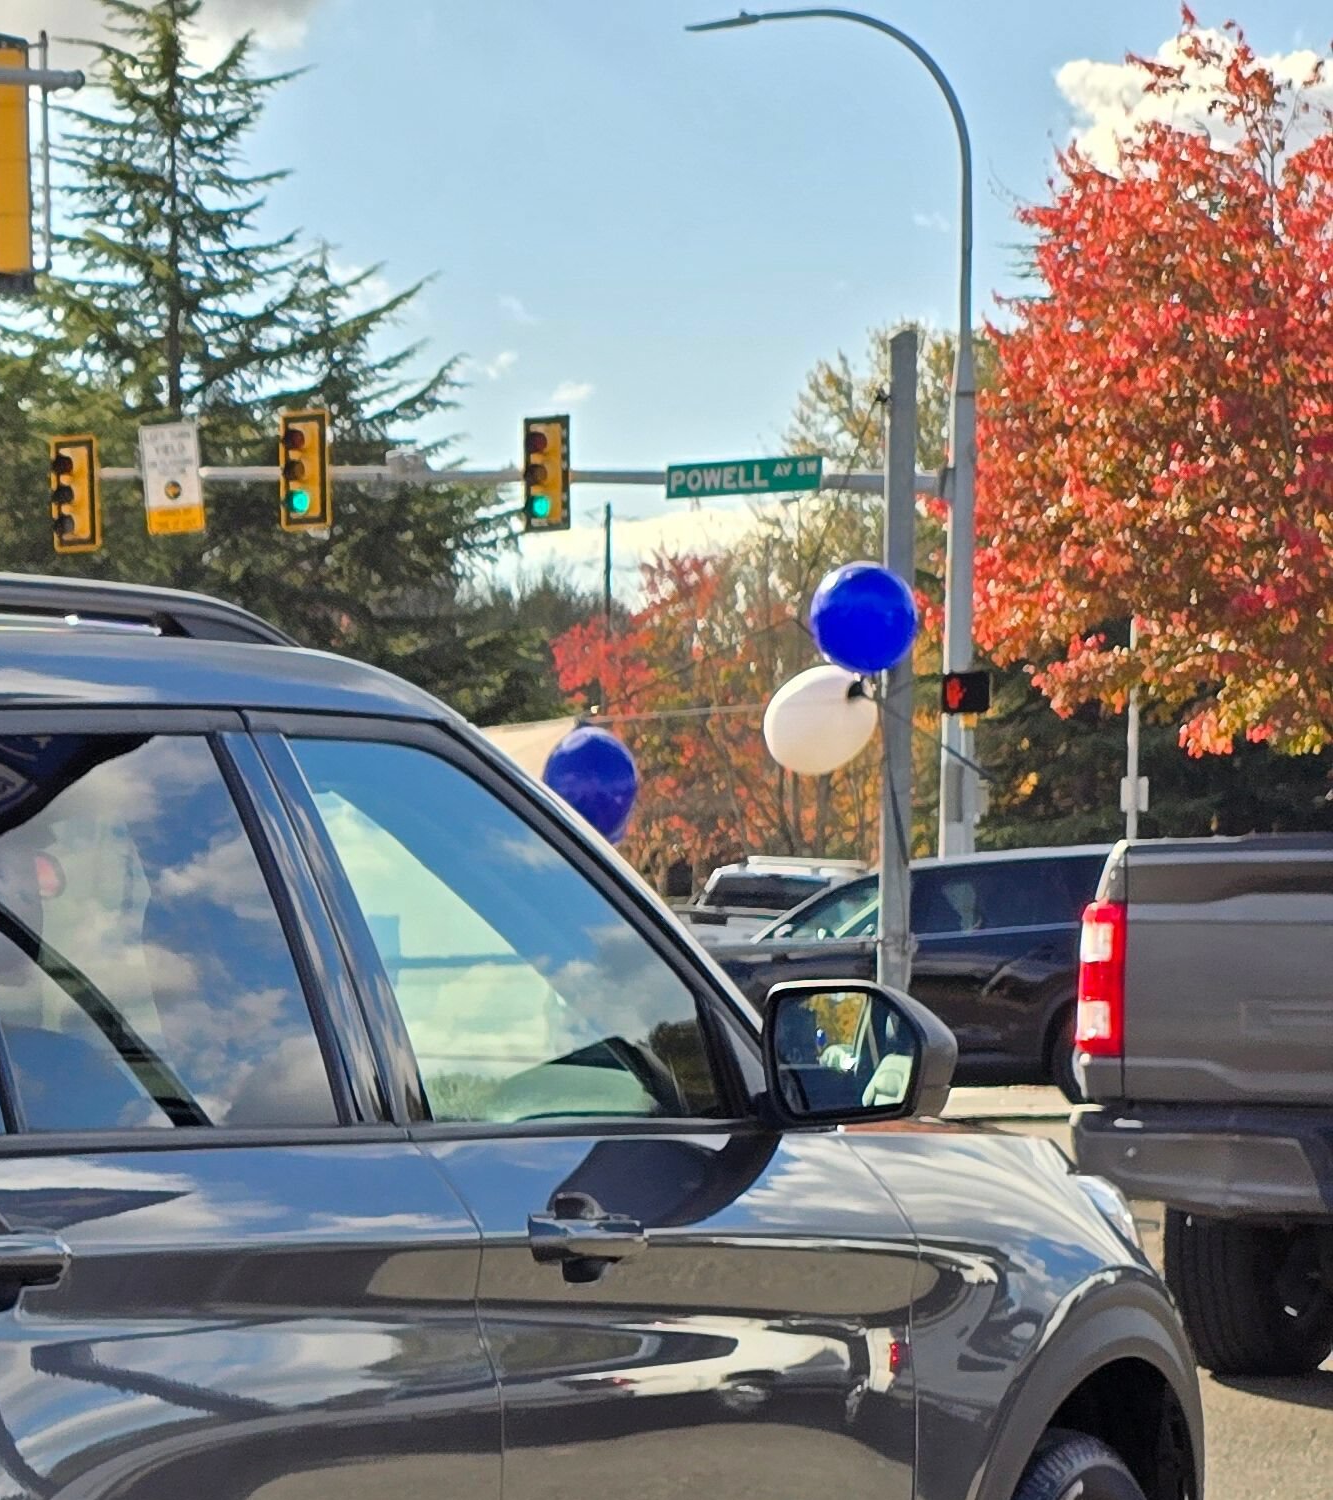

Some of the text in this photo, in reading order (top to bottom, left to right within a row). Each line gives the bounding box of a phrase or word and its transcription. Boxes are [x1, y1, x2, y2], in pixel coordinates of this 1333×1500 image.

[670, 461, 818, 493] POWELL AV SW
